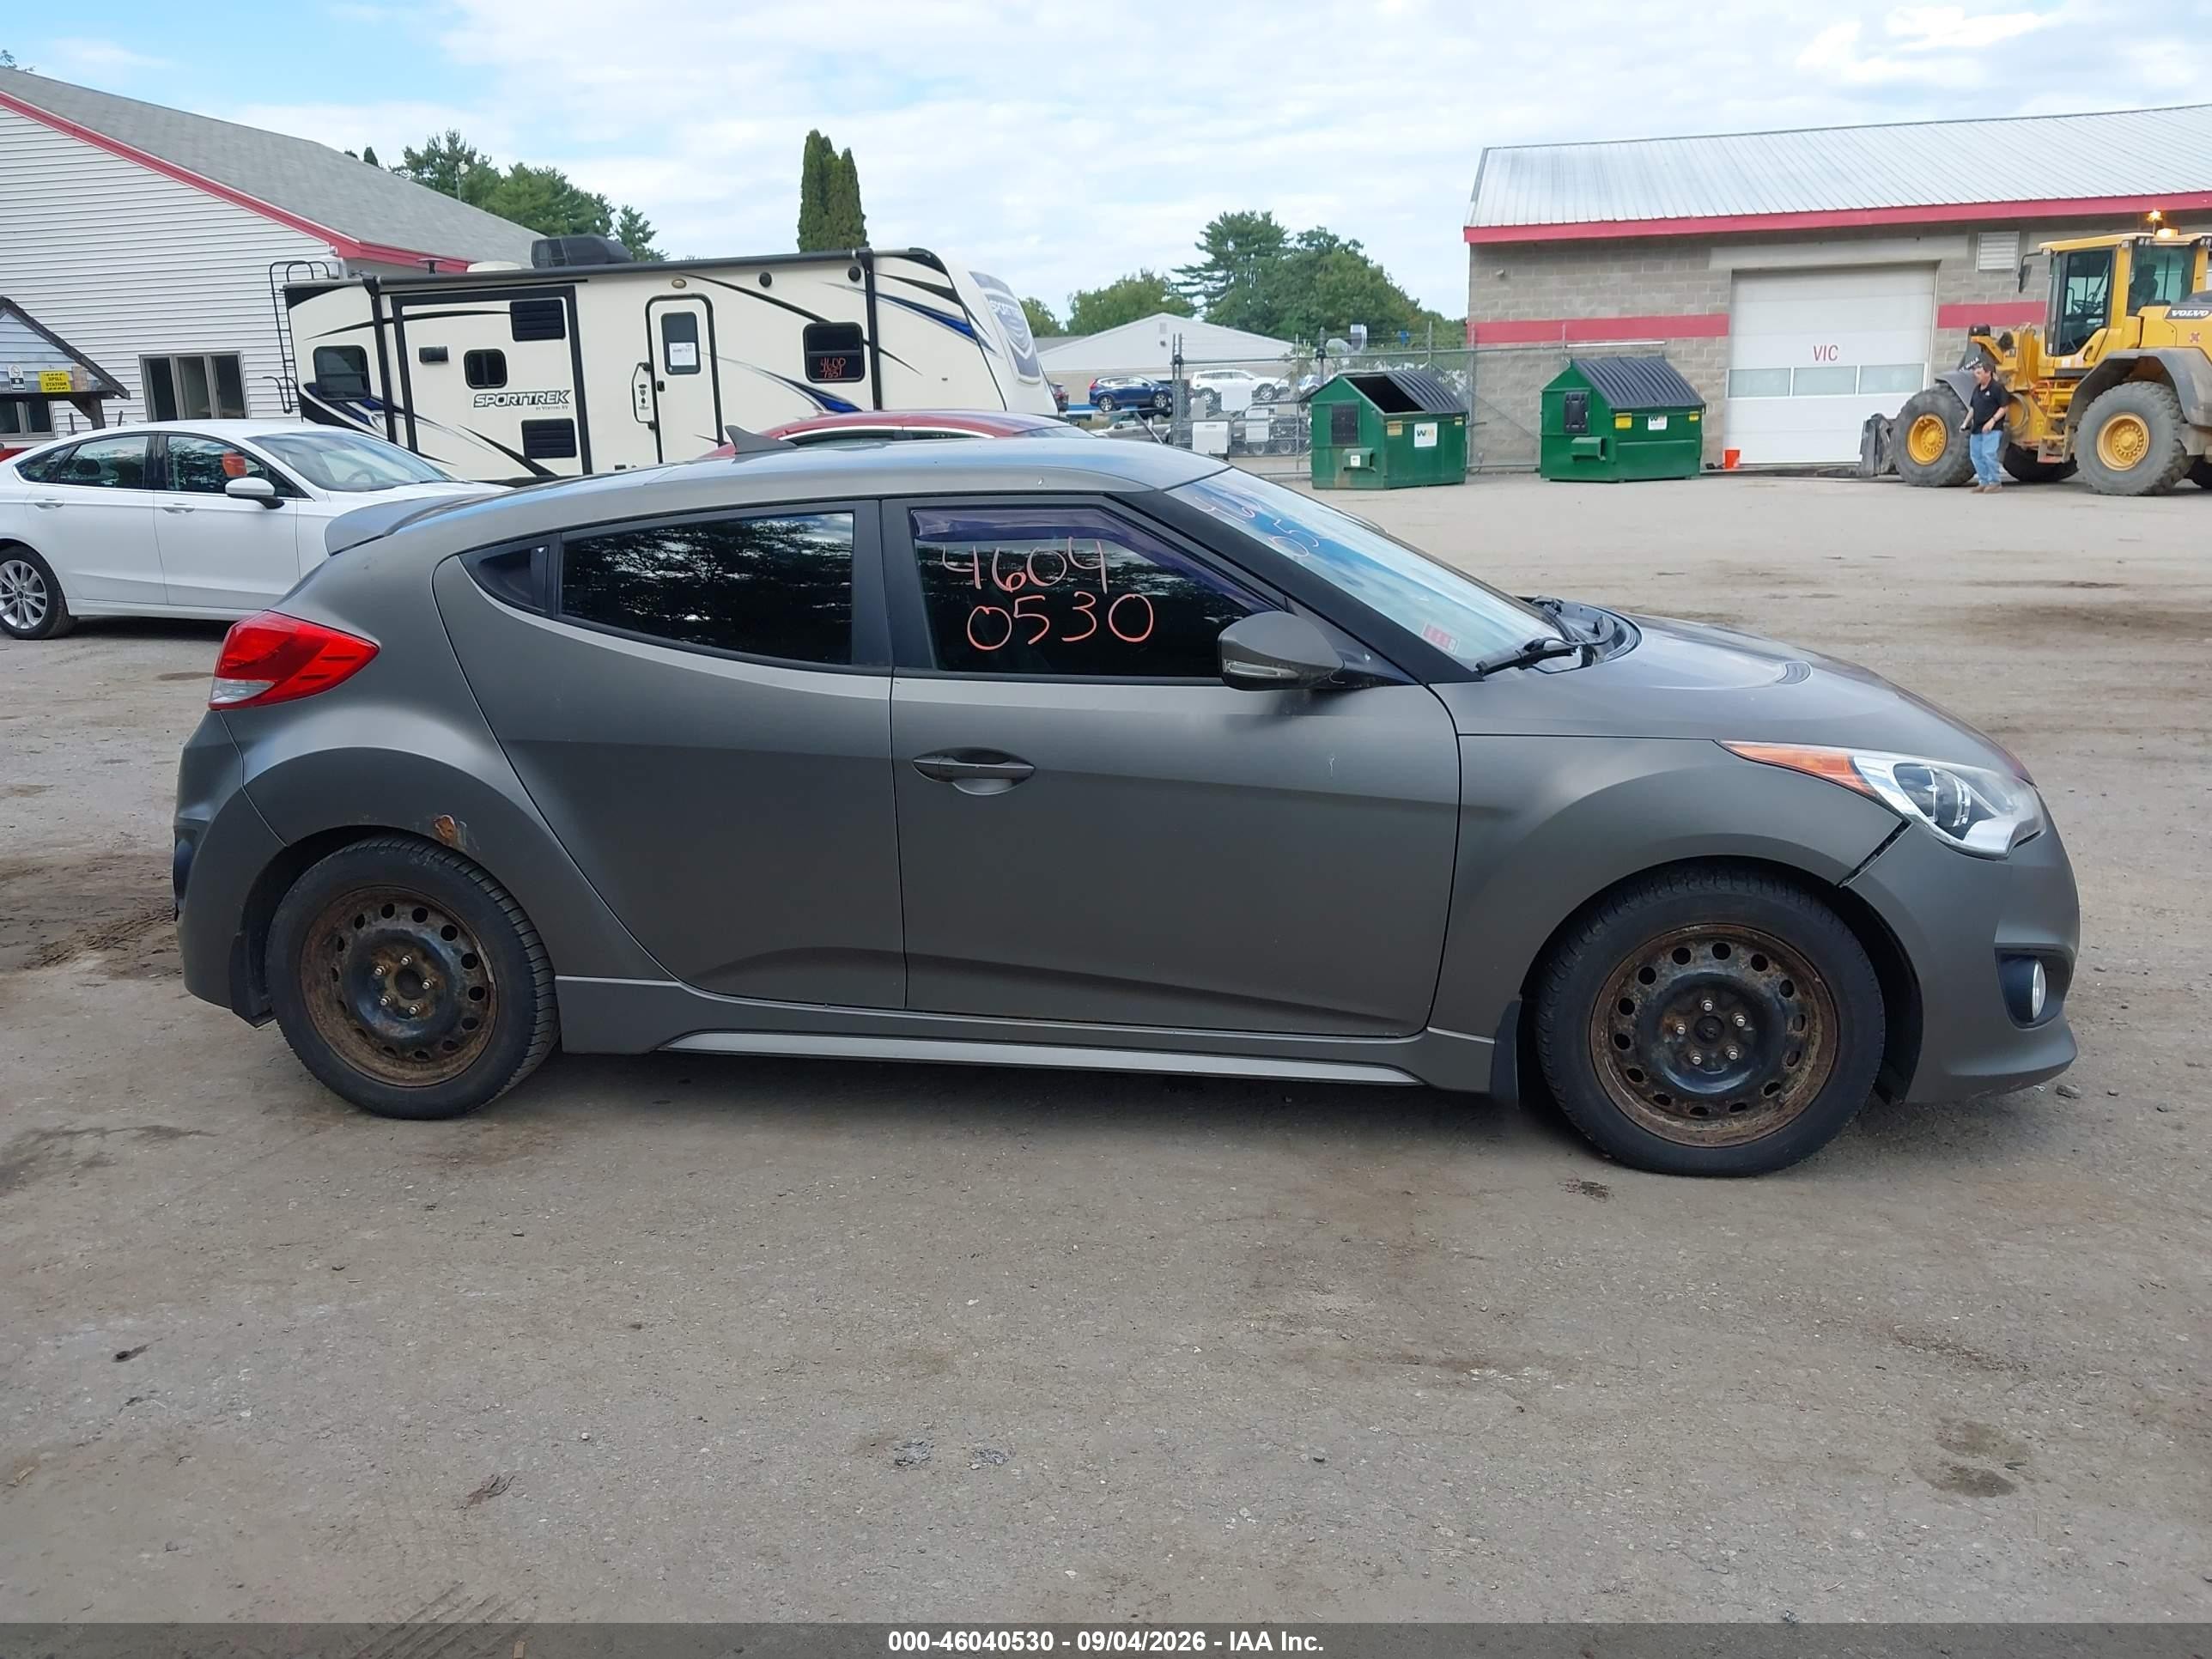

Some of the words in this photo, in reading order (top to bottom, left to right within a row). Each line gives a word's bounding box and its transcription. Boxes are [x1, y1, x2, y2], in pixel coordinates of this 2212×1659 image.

[1813, 344, 1838, 362] VIC
[474, 390, 572, 408] SPORTTREK
[942, 536, 1108, 594] 4604
[967, 591, 1154, 650] 0530
